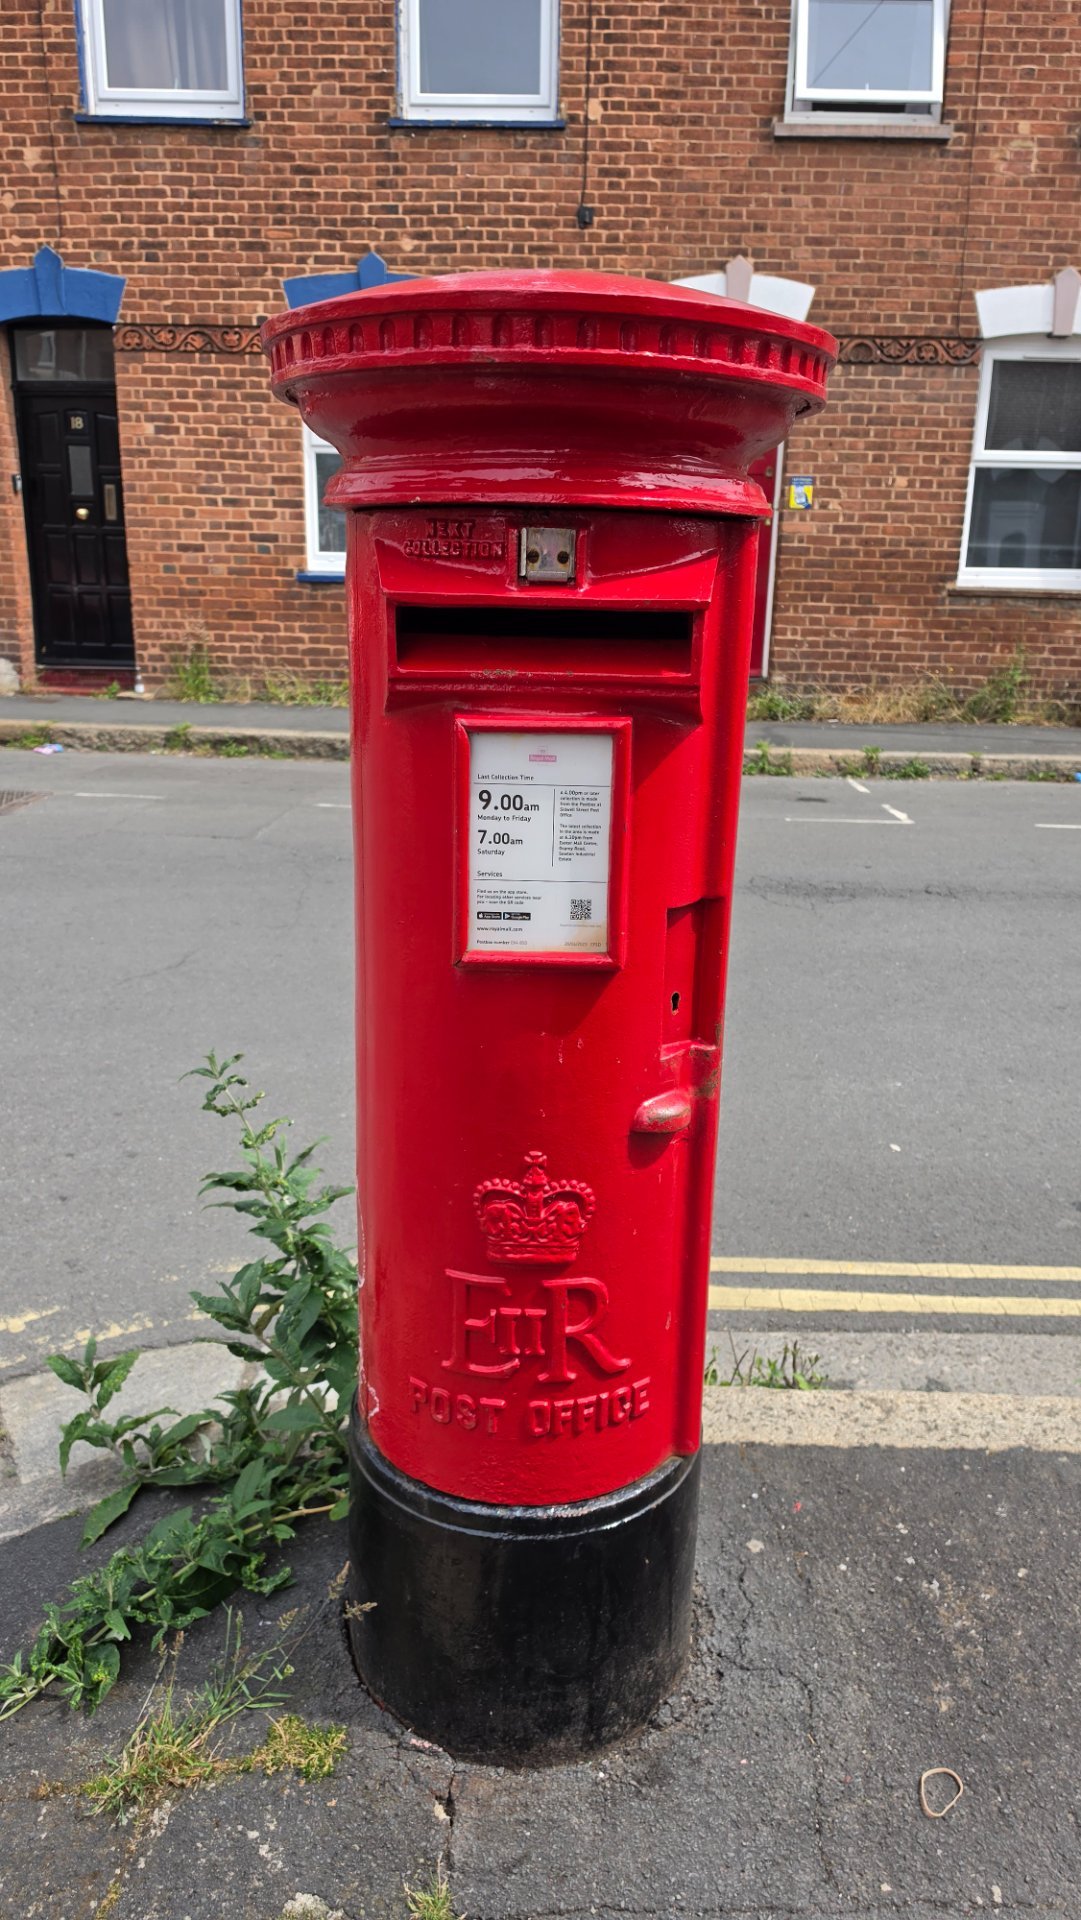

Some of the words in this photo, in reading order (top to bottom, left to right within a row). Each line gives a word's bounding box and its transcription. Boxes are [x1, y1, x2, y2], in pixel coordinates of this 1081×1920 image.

[70, 416, 84, 430] 18
[402, 539, 506, 560] COLLECTION
[478, 790, 540, 811] 9.00am
[478, 830, 523, 845] 7.00am
[408, 1376, 507, 1434] POST
[527, 1376, 650, 1440] OFFICE
